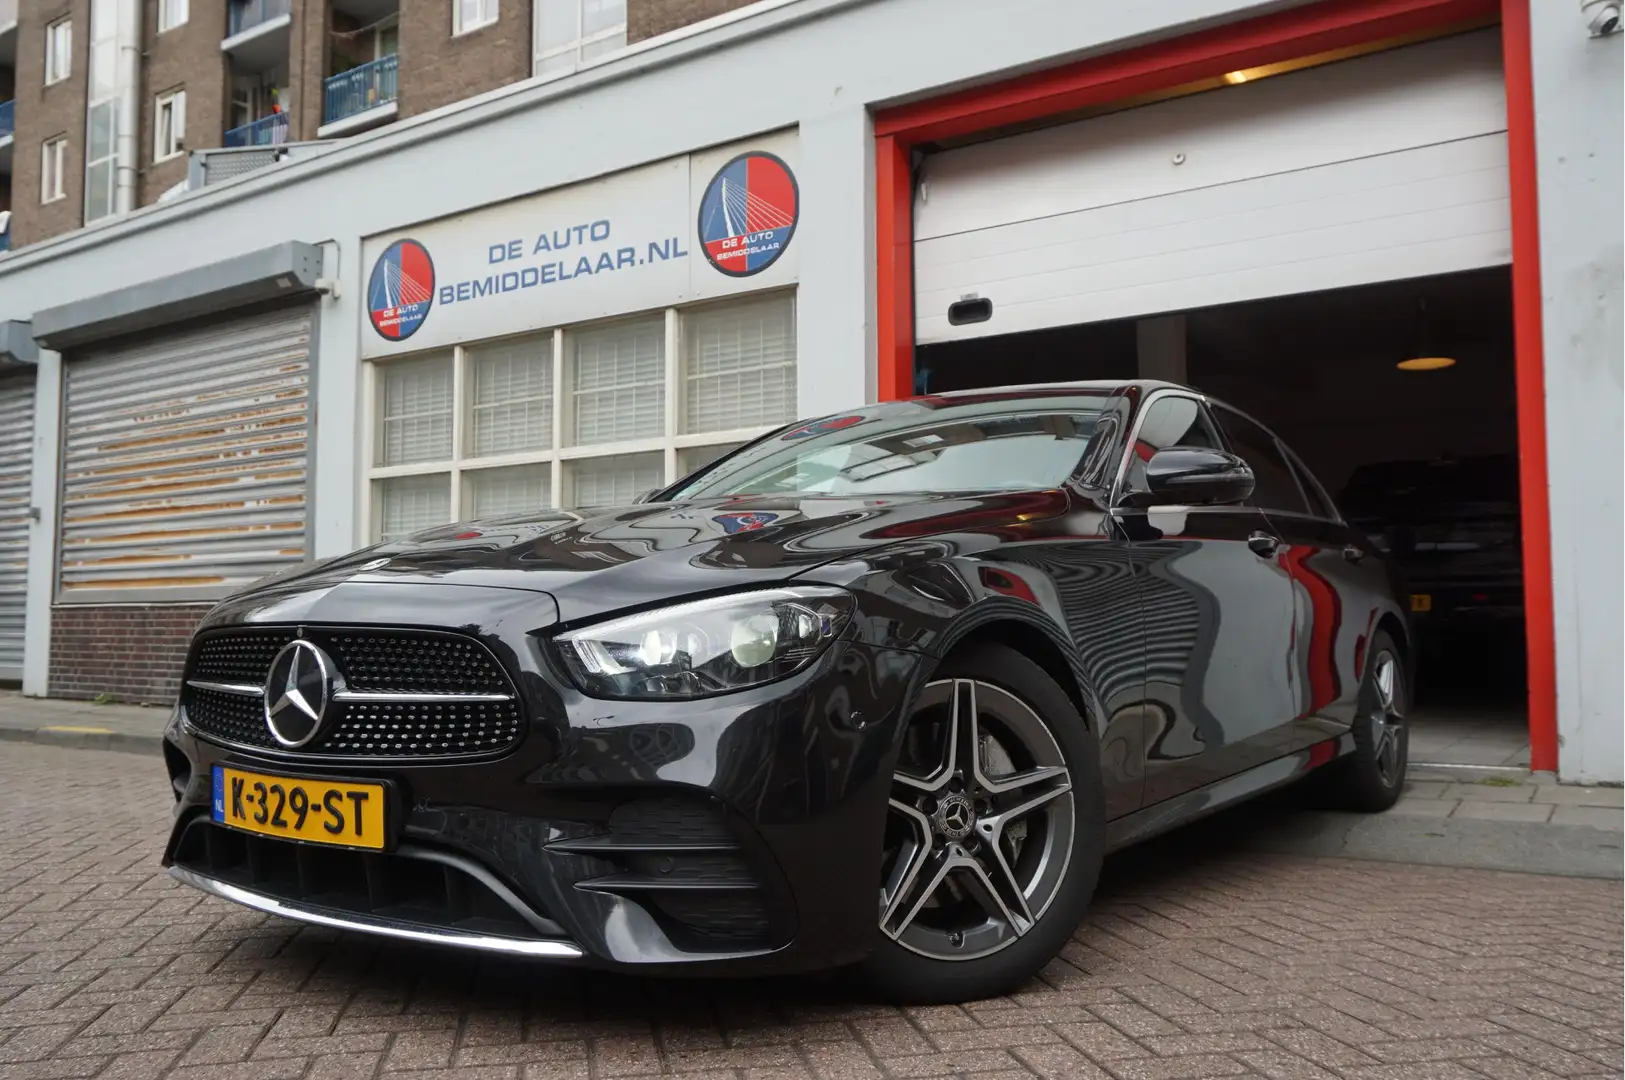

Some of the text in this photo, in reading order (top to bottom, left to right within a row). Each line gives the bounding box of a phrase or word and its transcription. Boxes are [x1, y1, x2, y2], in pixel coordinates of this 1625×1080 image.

[489, 219, 610, 264] DE AUTO
[722, 231, 774, 249] DE AUTO
[716, 242, 780, 260] BEMIDDELAAR
[439, 237, 688, 305] BEMIDDELAAR.NL
[383, 304, 418, 318] DE AUTO
[215, 799, 224, 813] NL
[231, 777, 369, 836] K-329-ST
